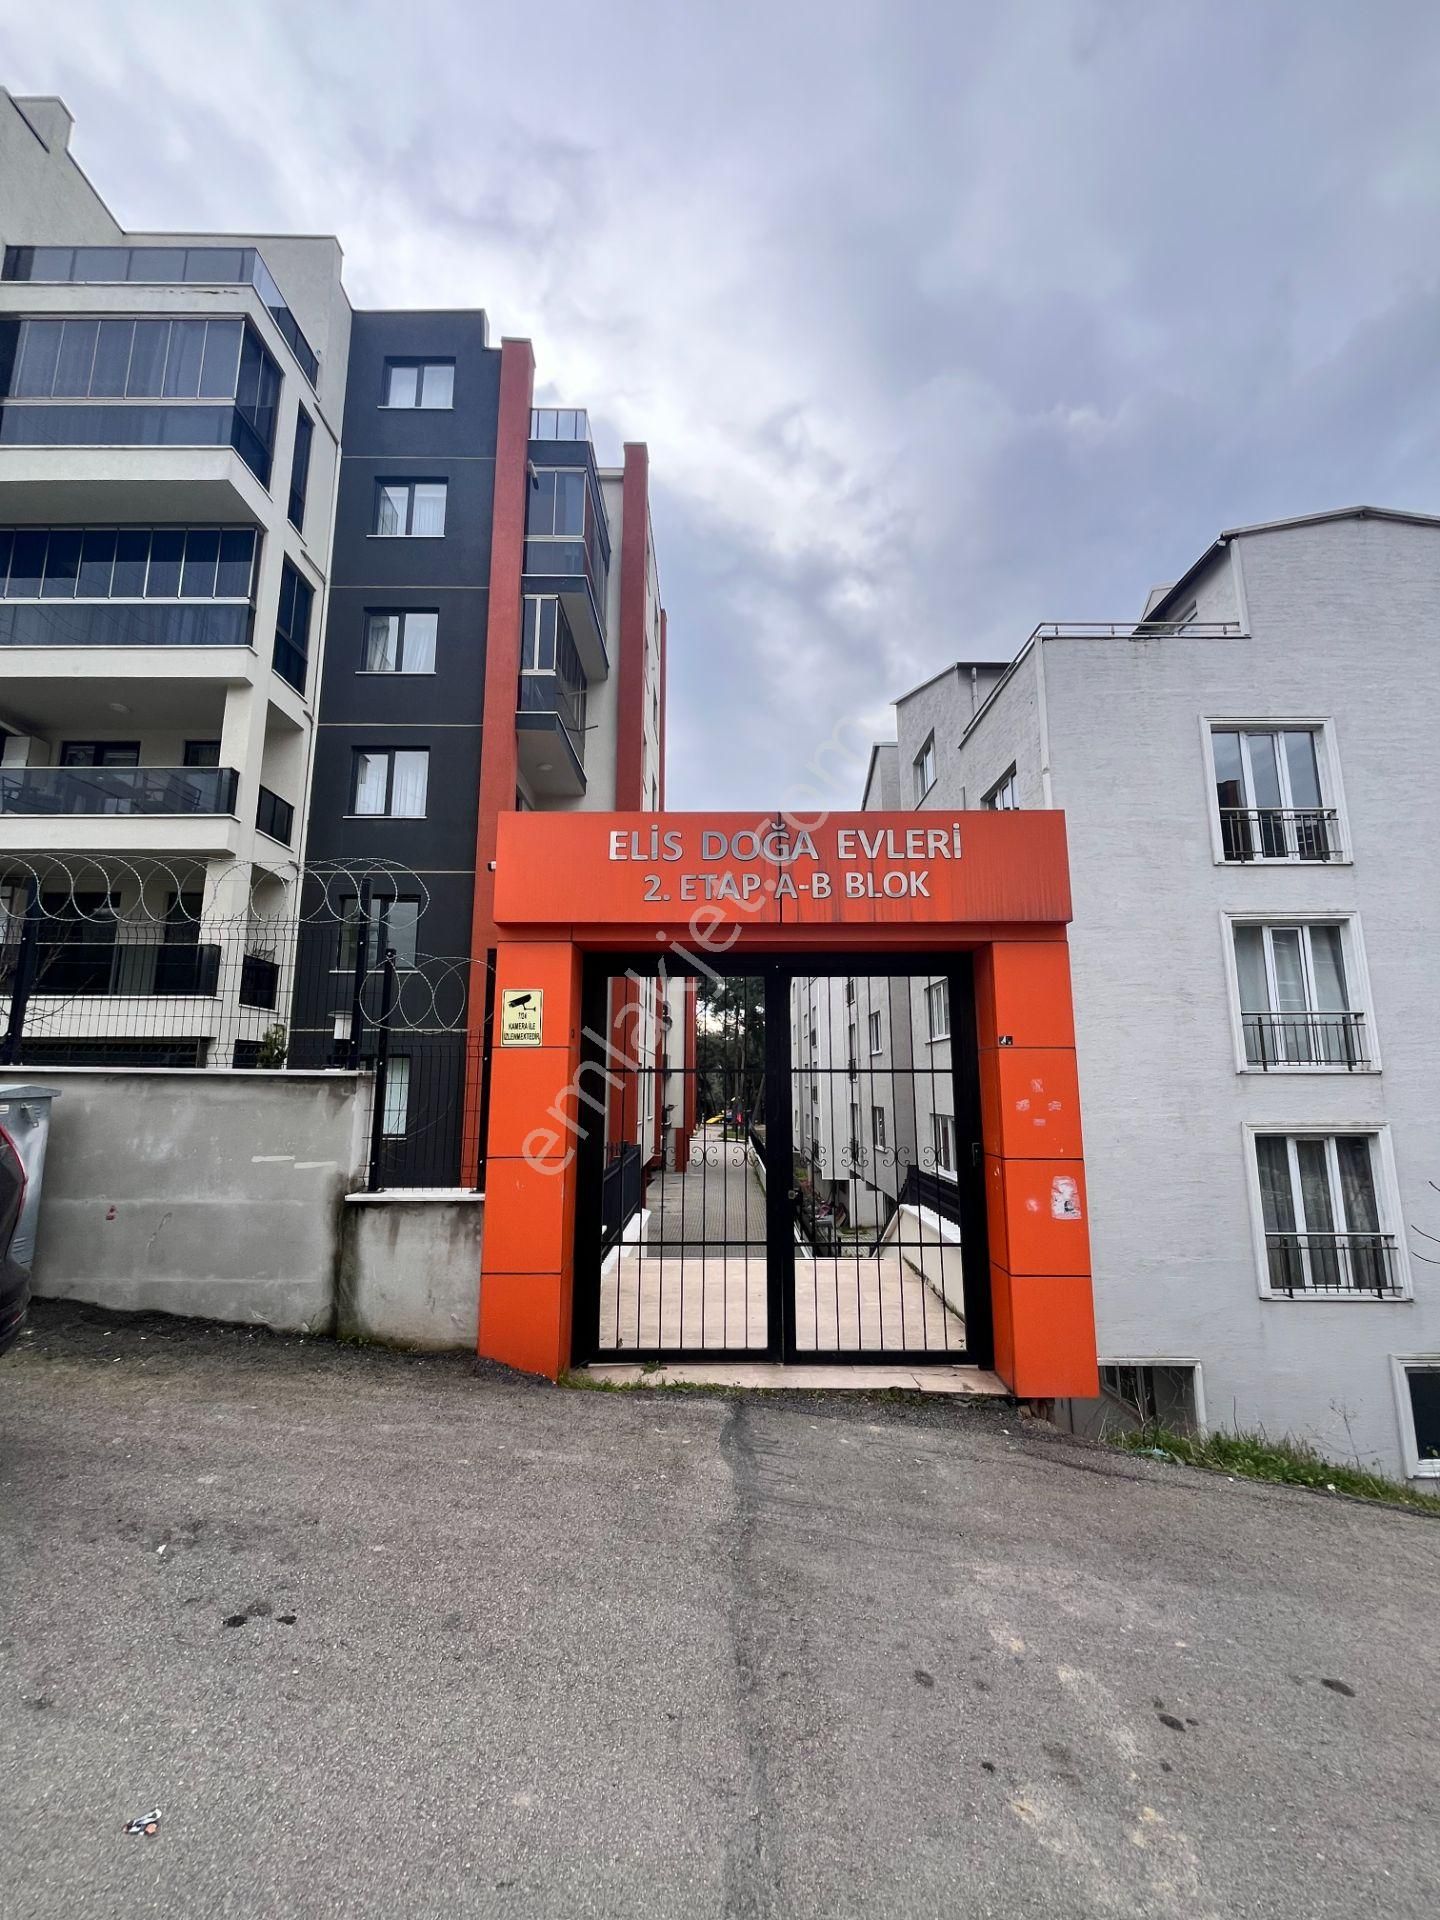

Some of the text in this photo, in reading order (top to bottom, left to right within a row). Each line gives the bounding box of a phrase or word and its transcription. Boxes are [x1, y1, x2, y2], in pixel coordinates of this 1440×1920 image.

[609, 823, 962, 861] ELİS DOĞA EVLERİ
[643, 871, 930, 901] 2. ETAP A-B BLOK
[508, 1023, 527, 1031] KAMERA
